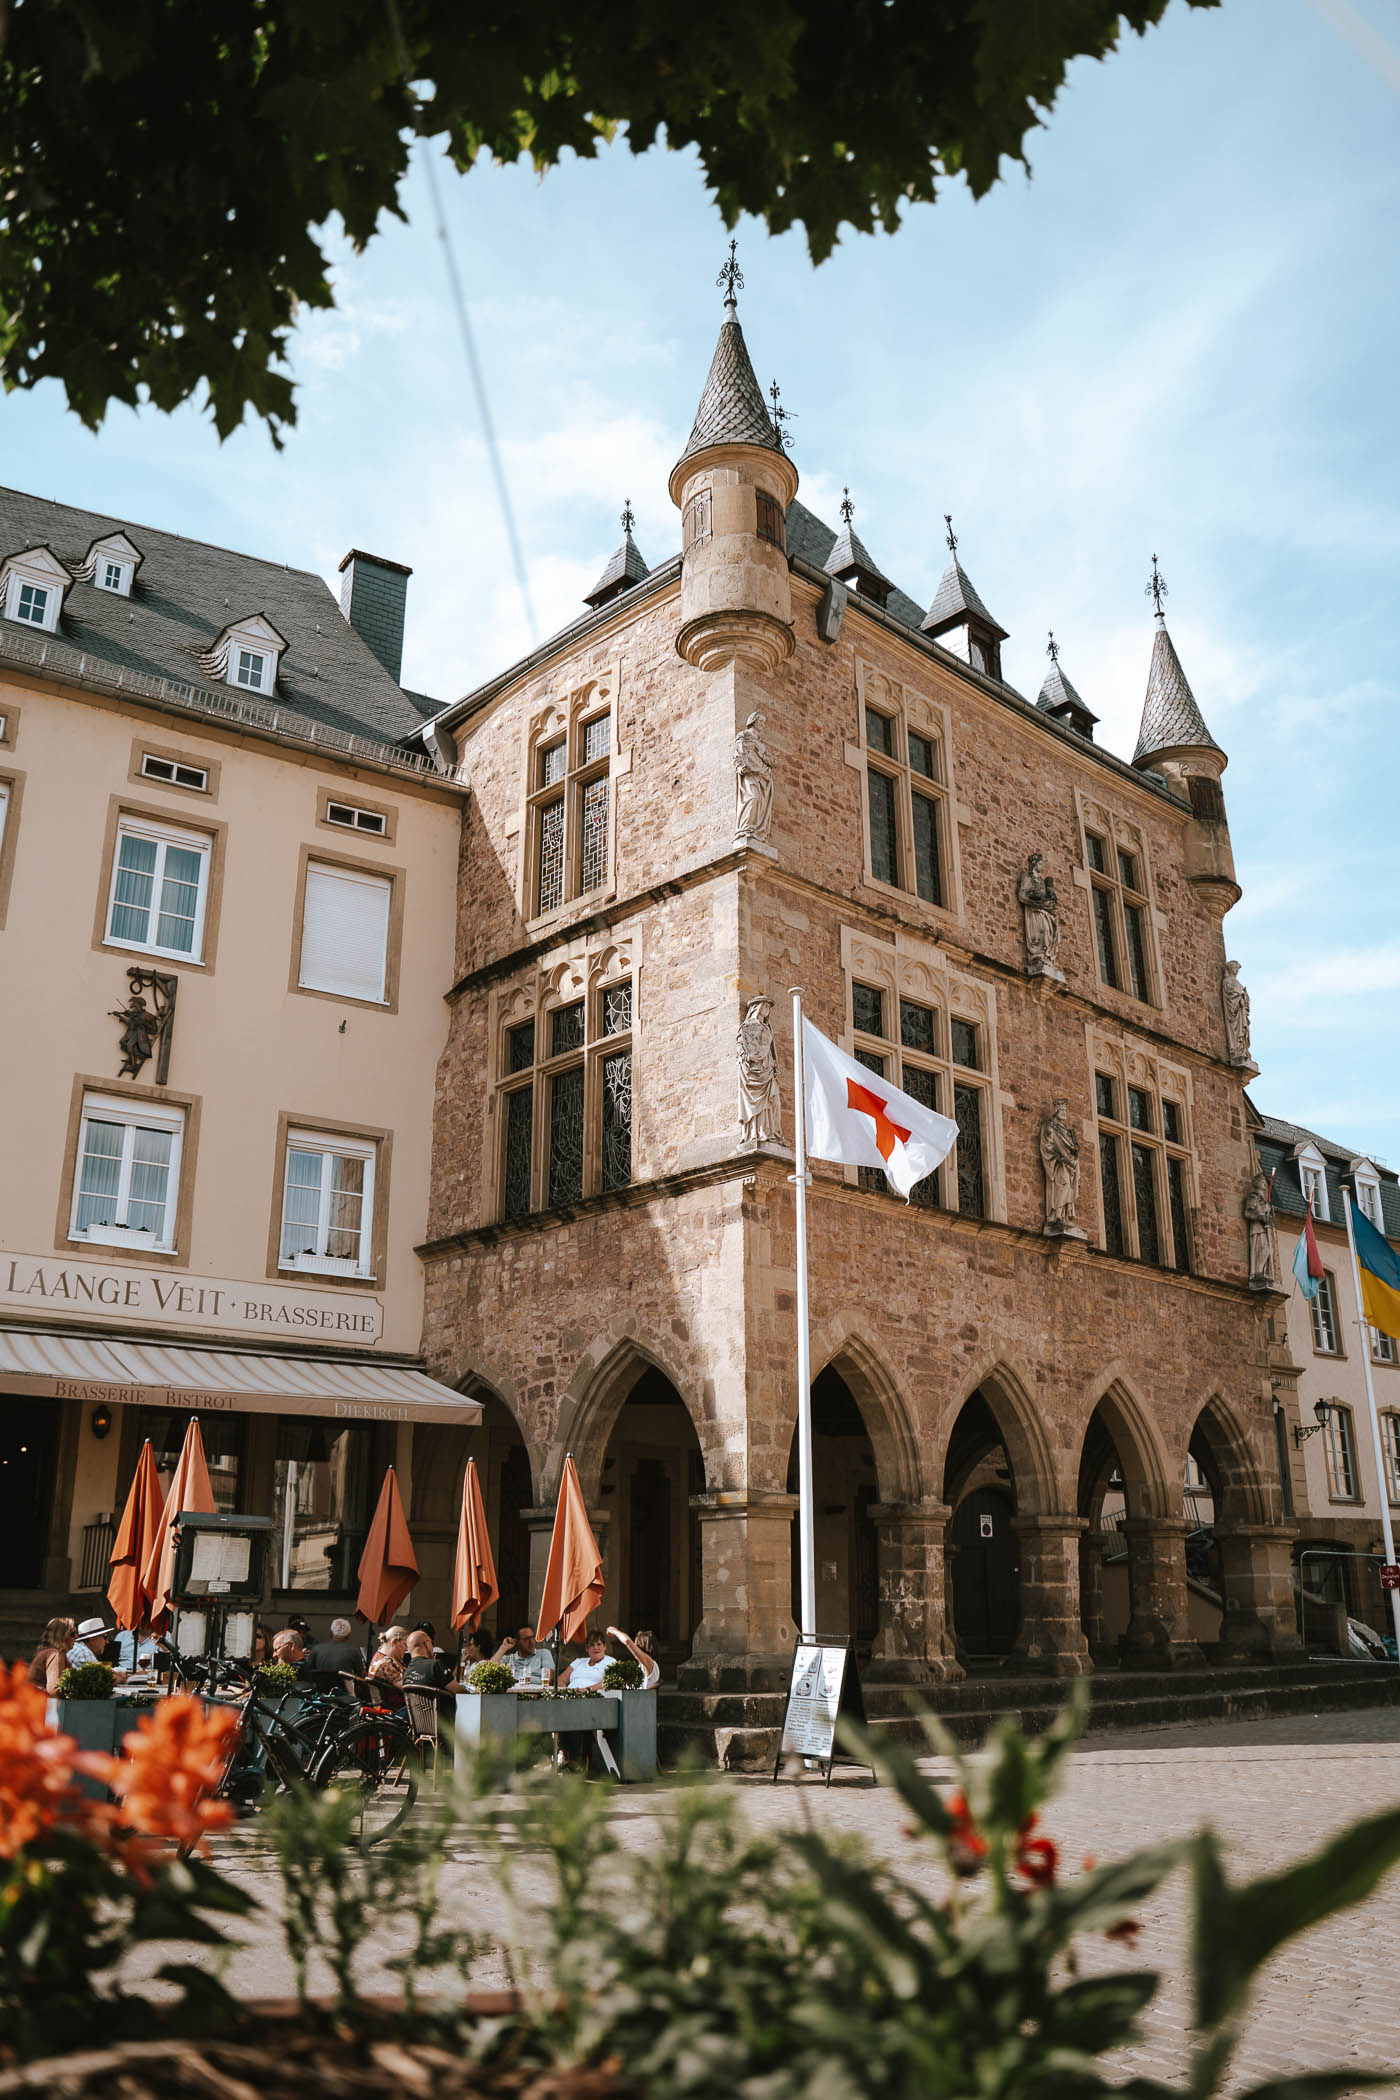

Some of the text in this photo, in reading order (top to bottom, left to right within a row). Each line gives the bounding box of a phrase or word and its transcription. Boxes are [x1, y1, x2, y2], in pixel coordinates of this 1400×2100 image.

[7, 1261, 375, 1333] LAANGE VEIT BRASSERIE
[55, 1381, 237, 1409] BRASSERIE BISTROT
[334, 1402, 409, 1420] DIEKIRCH
